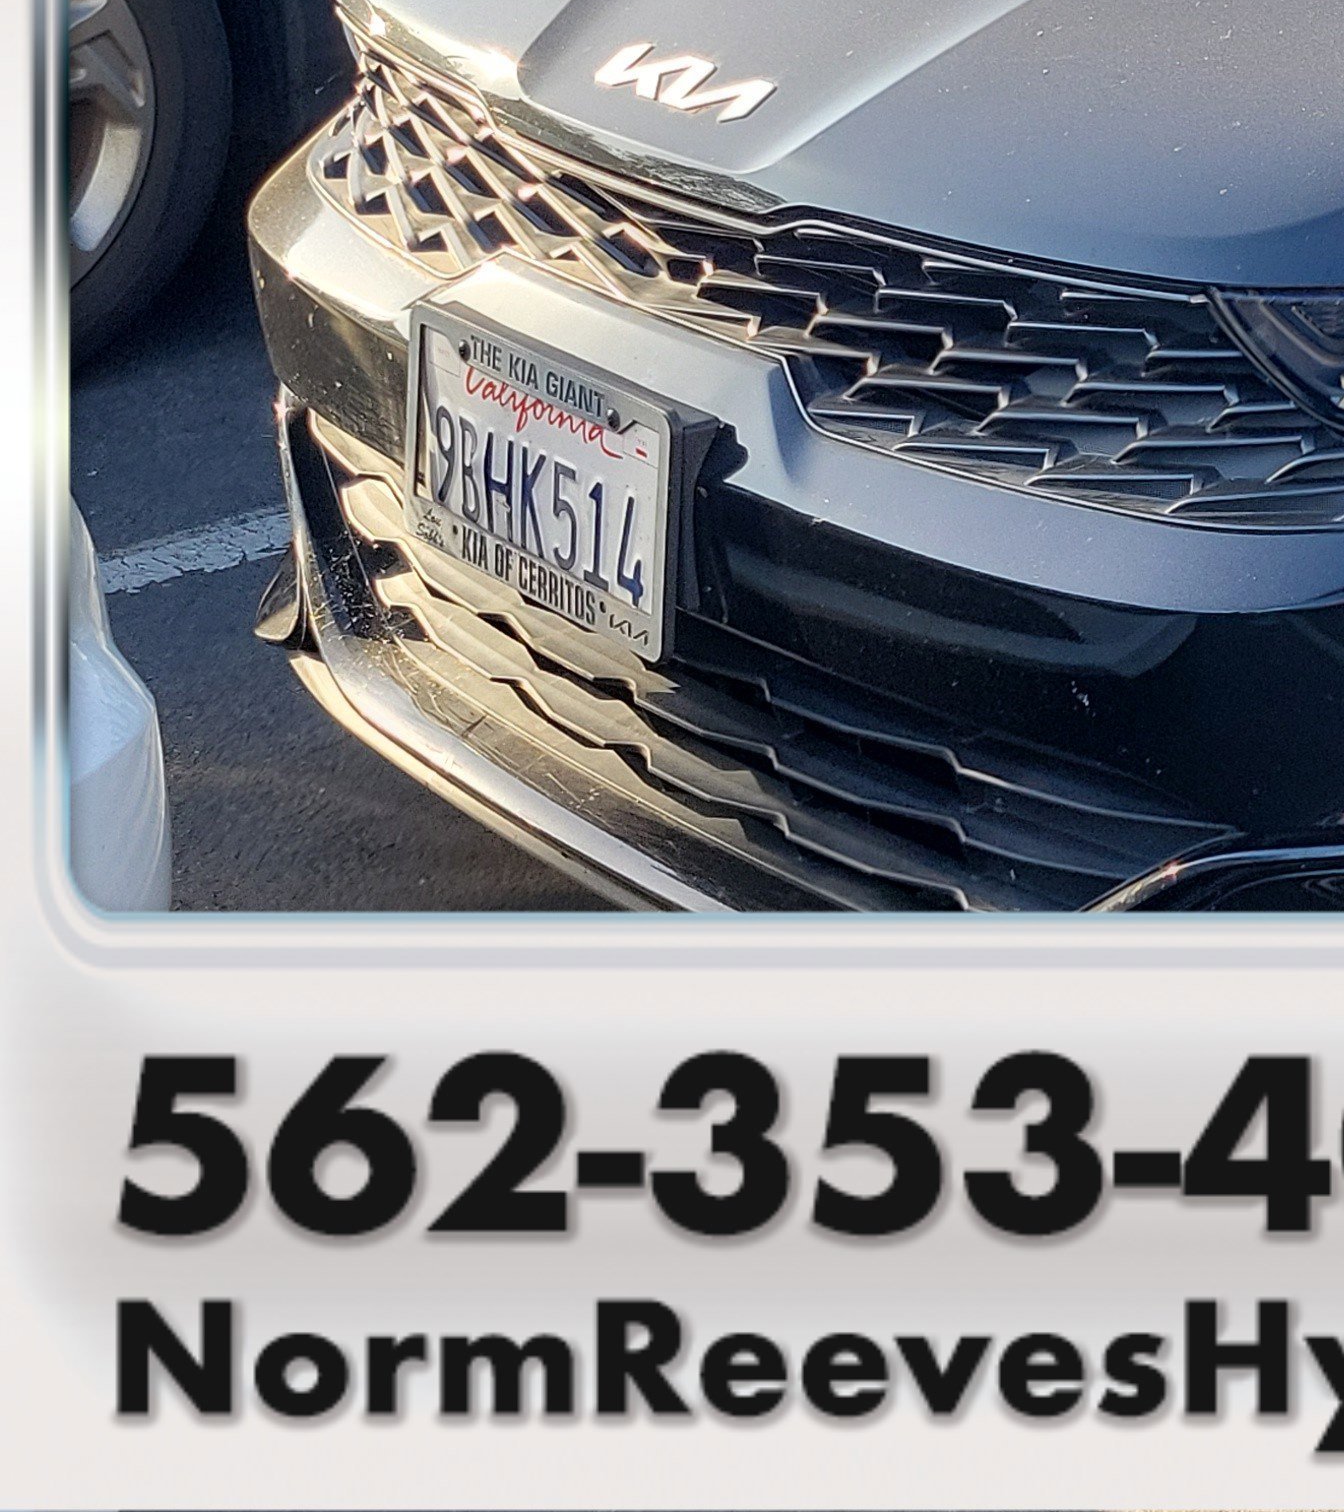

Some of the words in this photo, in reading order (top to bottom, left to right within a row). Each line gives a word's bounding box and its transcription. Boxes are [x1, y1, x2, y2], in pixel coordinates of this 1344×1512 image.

[594, 42, 778, 123] KIA
[465, 365, 624, 460] California
[470, 334, 502, 372] THE
[508, 353, 539, 390] KIA
[545, 369, 605, 418] GIANT
[435, 404, 645, 608] 9BHK514
[461, 524, 489, 570] KIA
[494, 543, 514, 581] OF
[518, 555, 597, 626] CERRITOS
